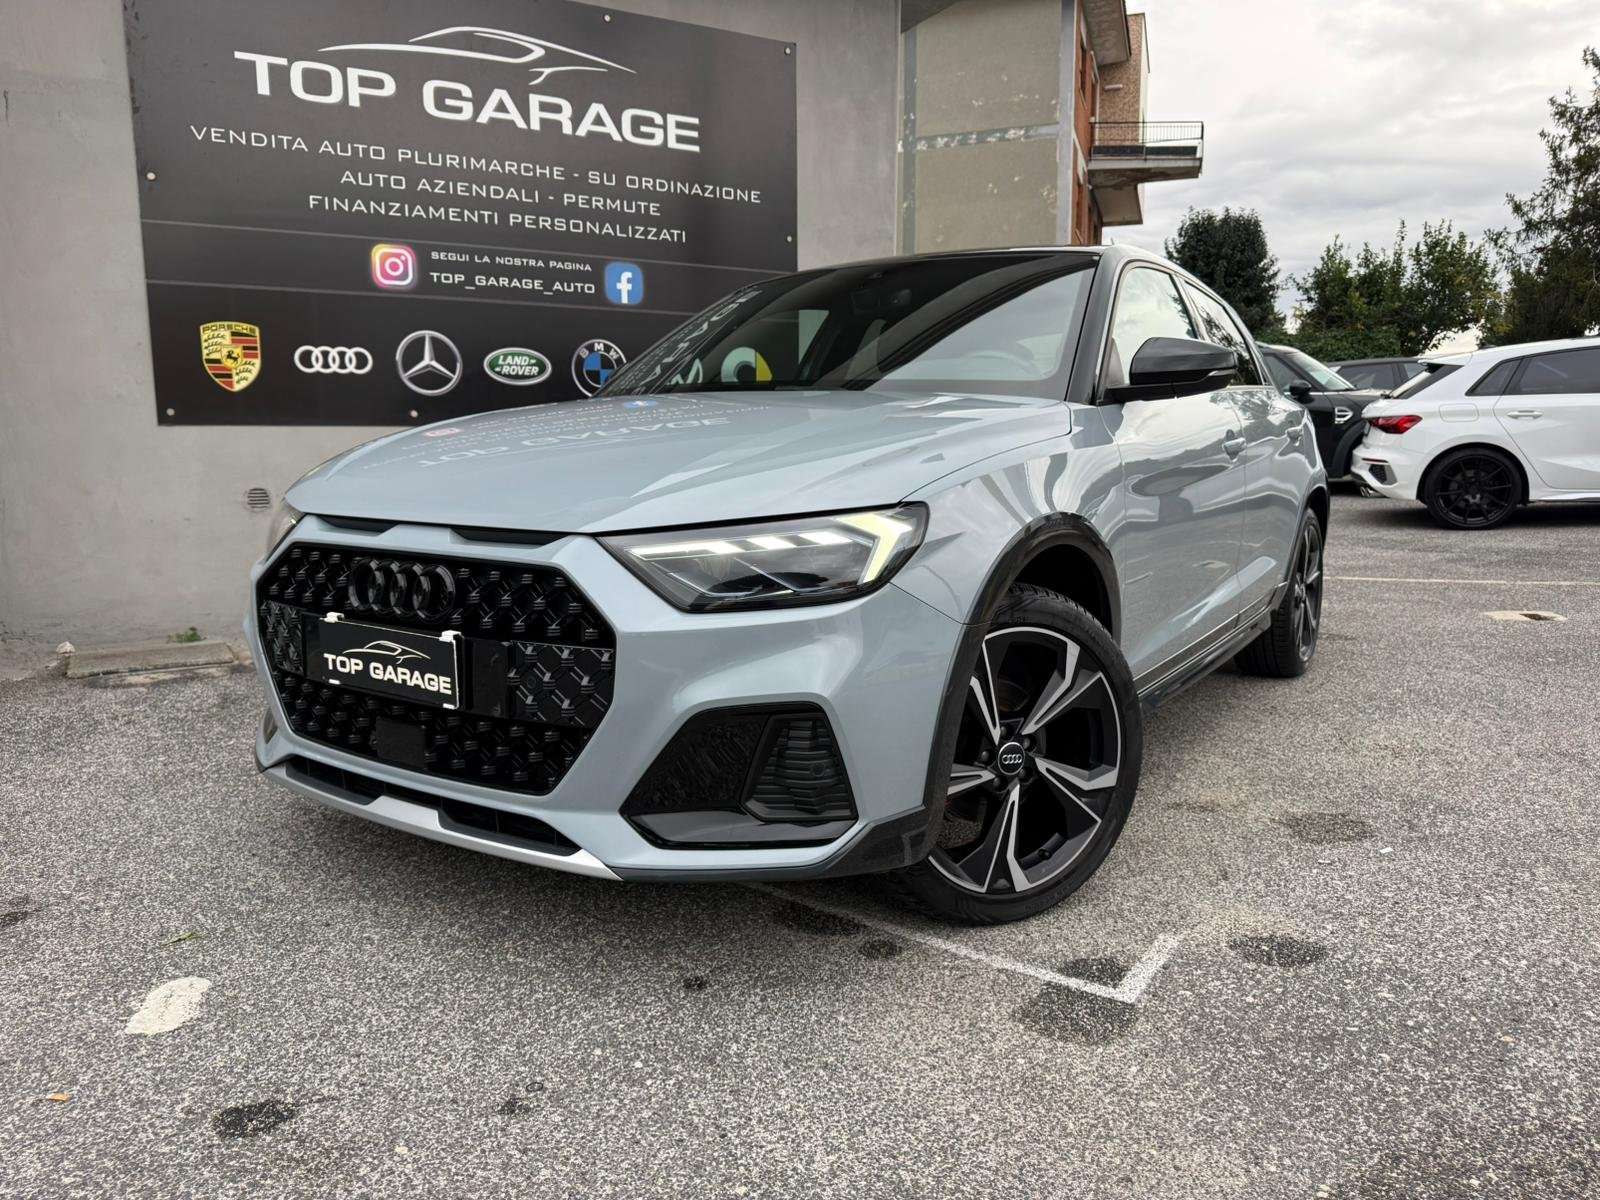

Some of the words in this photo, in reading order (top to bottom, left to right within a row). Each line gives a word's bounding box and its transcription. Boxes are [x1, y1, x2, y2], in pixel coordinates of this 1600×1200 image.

[234, 51, 396, 107] TOP
[422, 80, 700, 152] GARAGE
[191, 125, 308, 151] VENDITA
[319, 141, 385, 160] AUTO
[398, 149, 565, 180] PLURIMARCHE
[589, 171, 615, 186] SU
[626, 176, 761, 203] ORDINAZIONE
[341, 171, 406, 189] AUTO
[417, 178, 538, 203] AZIENDALI
[564, 194, 660, 216] PERMUTE
[310, 195, 498, 225] FINANZIAMENTI
[510, 214, 685, 243] PERSONALIZZATI
[431, 251, 469, 262] SEGUI
[474, 255, 491, 264] LA
[496, 256, 545, 268] NOSTRA
[549, 261, 592, 272] PAGINA
[430, 272, 596, 295] TOP_GARAGE_AUTO
[498, 355, 529, 365] LAND
[501, 366, 539, 376] ROVER
[323, 653, 364, 675] TOP
[369, 662, 452, 695] GARAGE
